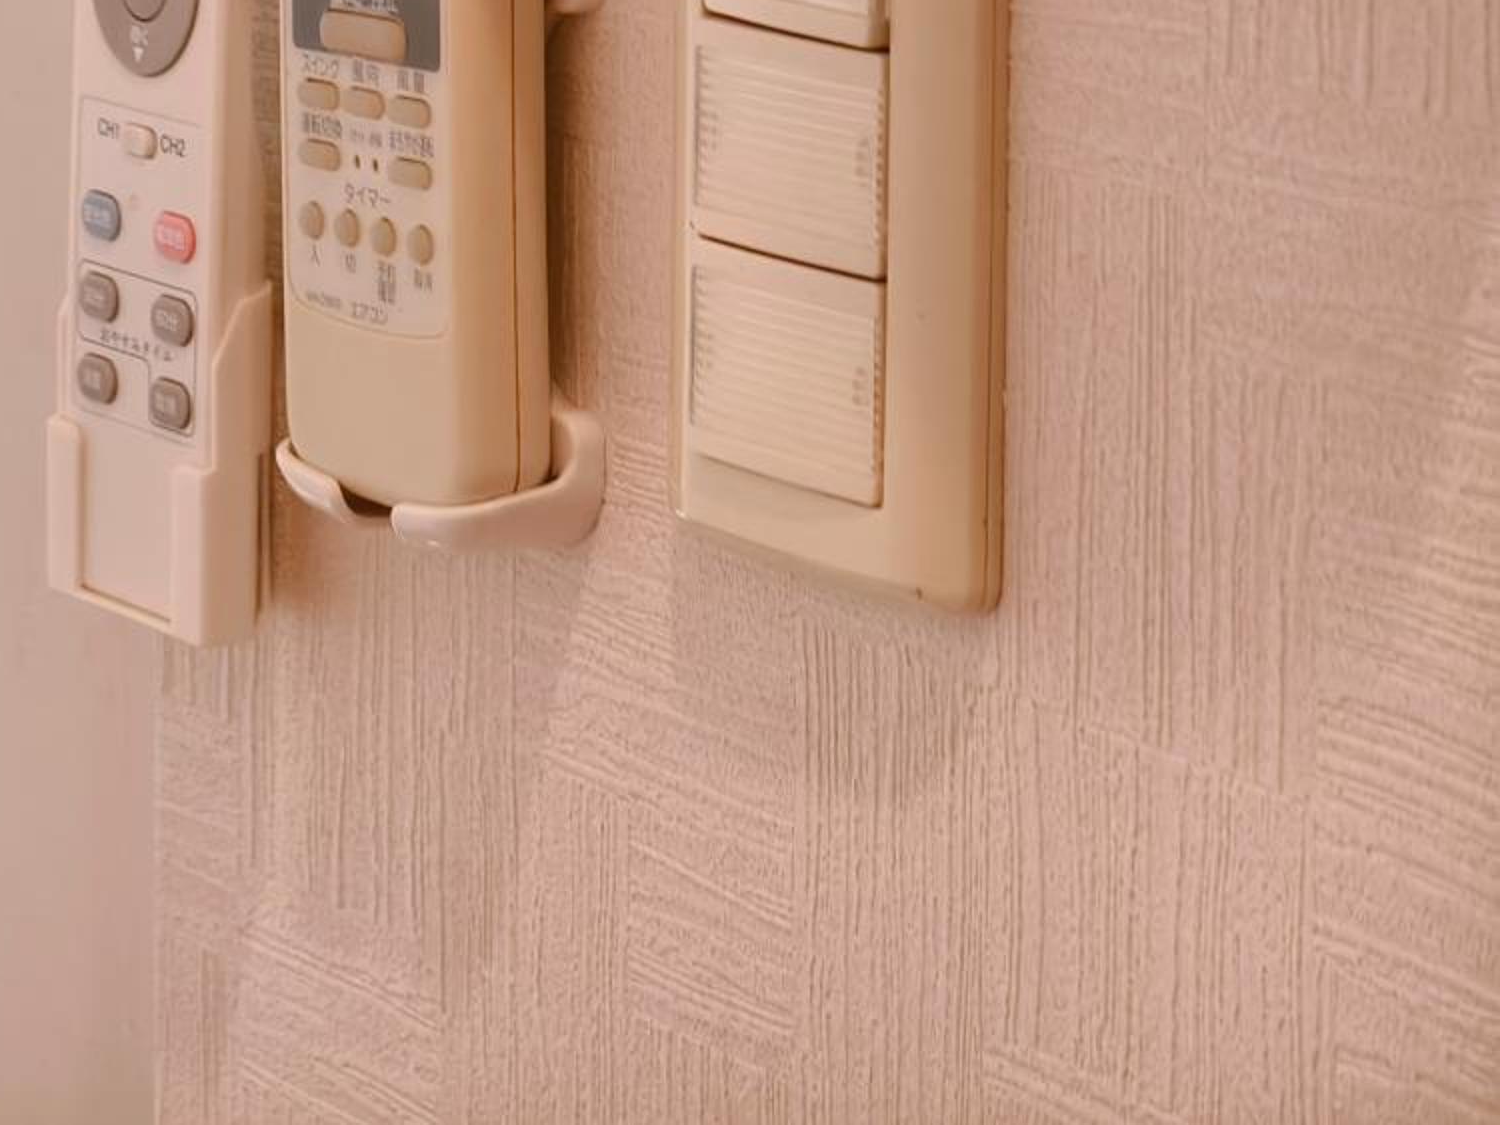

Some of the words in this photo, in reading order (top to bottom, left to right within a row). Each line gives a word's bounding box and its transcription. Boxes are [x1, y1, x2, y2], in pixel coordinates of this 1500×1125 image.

[302, 53, 340, 79] スイング
[98, 118, 119, 140] CH1
[160, 134, 186, 158] CH2
[344, 183, 392, 207] タイマー
[350, 301, 390, 326] エアコン
